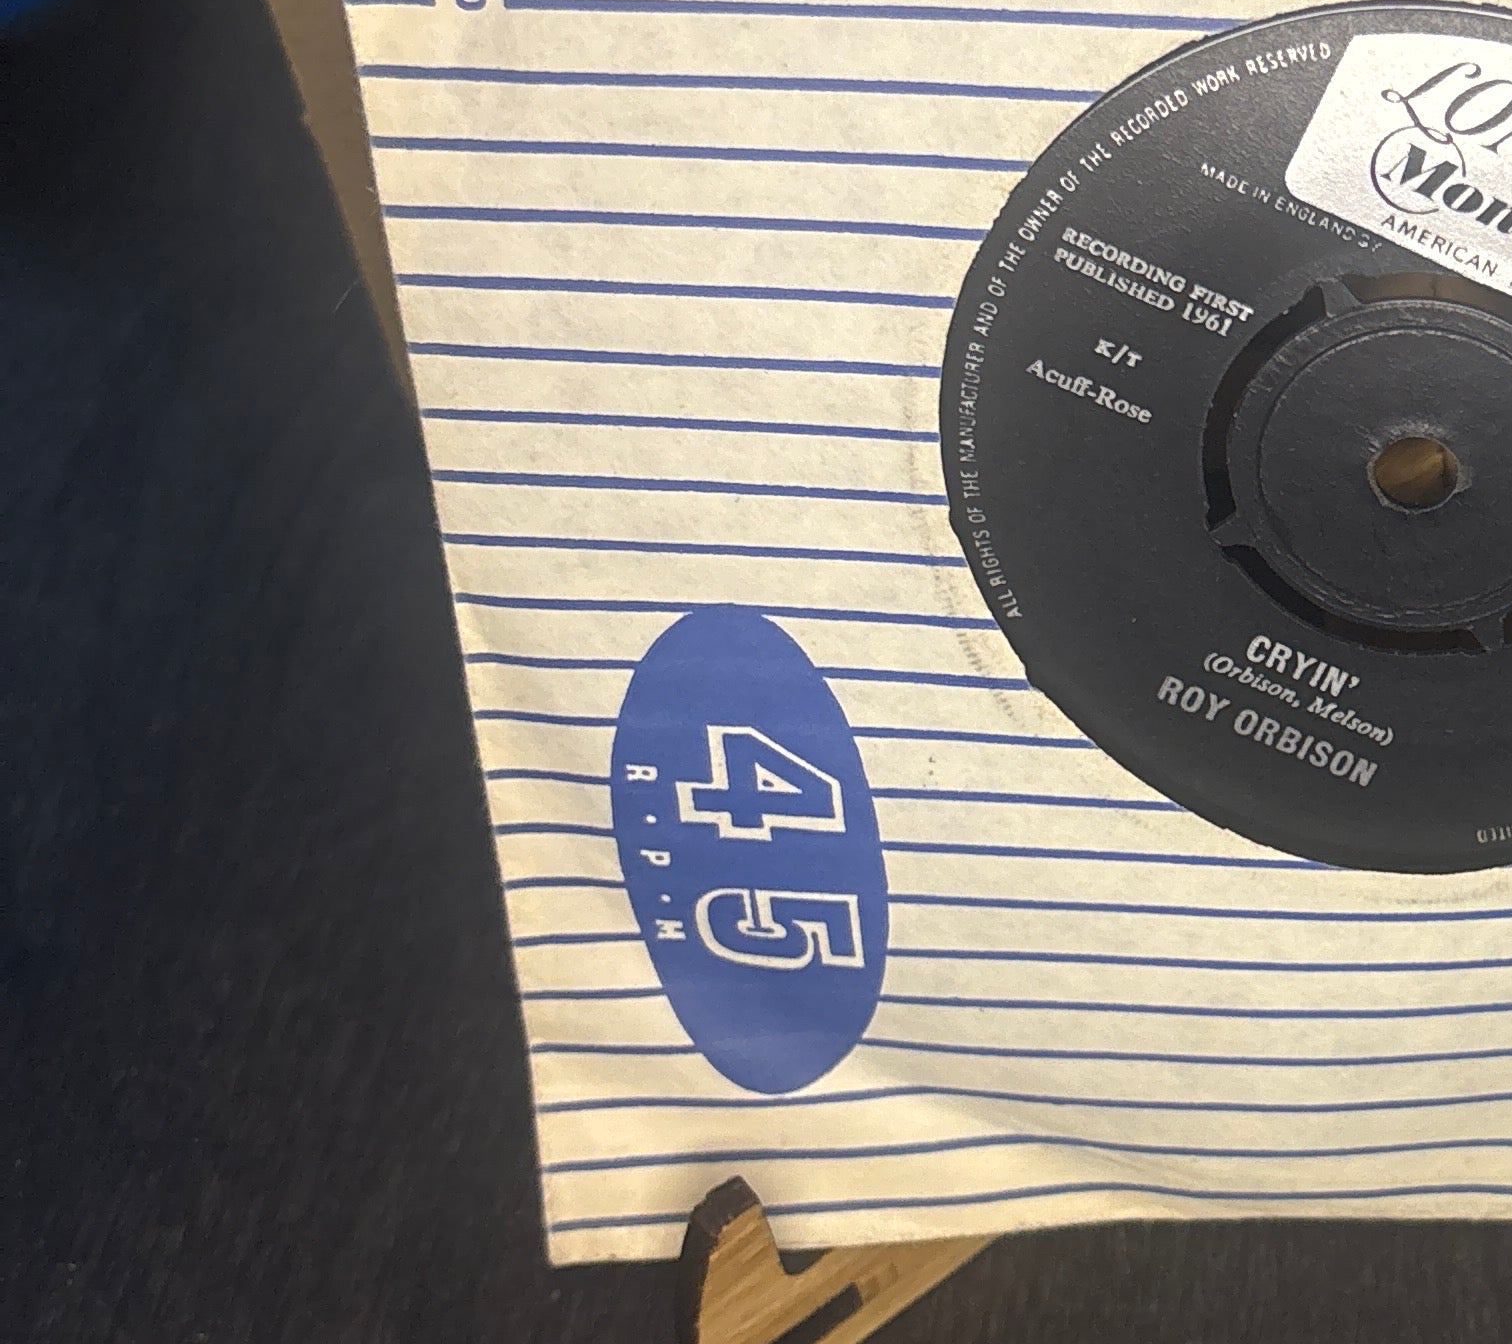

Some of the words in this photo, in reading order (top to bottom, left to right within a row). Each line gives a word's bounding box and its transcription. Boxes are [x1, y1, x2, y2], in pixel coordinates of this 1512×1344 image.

[1191, 65, 1242, 98] WORK
[1245, 41, 1332, 77] RESERVED
[1109, 88, 1190, 147] RECORDED
[1059, 170, 1081, 193] OF
[1078, 142, 1113, 173] THE
[1017, 189, 1064, 243] OWNER
[1199, 162, 1250, 195] MADE
[1251, 186, 1272, 204] IN
[1273, 196, 1357, 242] ENGLAND
[998, 242, 1026, 273] THE
[1380, 214, 1499, 278] AMERICAN
[987, 275, 1007, 298] OF
[1053, 246, 1176, 312] PUBLISHED
[1181, 302, 1233, 337] 1961
[1060, 226, 1187, 294] RECORDING
[1188, 283, 1255, 322] FIRST
[973, 300, 999, 338] AND
[1093, 338, 1143, 369] K/T
[958, 343, 986, 463] MANUFACTURER
[1025, 359, 1153, 424] Acuff-Rose
[959, 469, 982, 500] THE
[966, 506, 988, 525] OF
[971, 530, 1008, 588] RIGHTS
[997, 589, 1023, 619] ALL
[1203, 652, 1302, 708] (Orbison,
[1306, 695, 1395, 747] Melson)
[1156, 674, 1231, 722] ROY
[1232, 708, 1379, 788] ORBISON
[674, 724, 865, 970] 45
